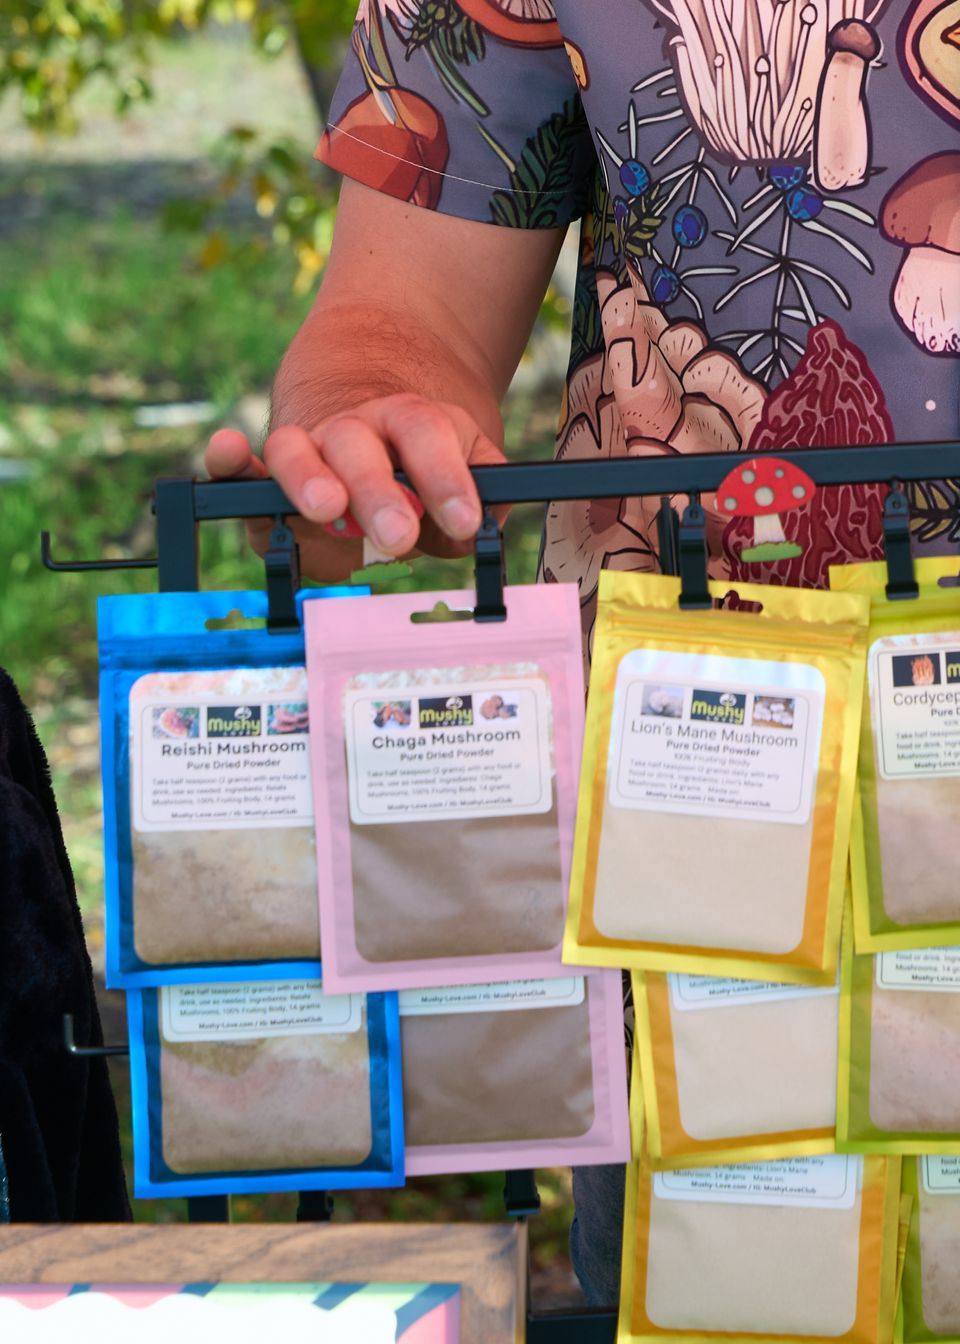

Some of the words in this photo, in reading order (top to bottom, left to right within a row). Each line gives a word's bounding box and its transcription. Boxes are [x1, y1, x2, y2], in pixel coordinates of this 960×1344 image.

[420, 705, 473, 726] Mushy
[691, 700, 744, 725] Mushy
[931, 708, 953, 717] Pure
[208, 716, 260, 735] Mushy
[632, 720, 672, 736] Lion's
[677, 725, 717, 740] Mane
[722, 730, 798, 748] Mushroom
[162, 742, 212, 756] Reishi
[217, 741, 306, 755] Mushroom
[372, 735, 426, 750] Chaga
[432, 729, 520, 745] Mushroom
[666, 739, 689, 750] Pure
[692, 742, 720, 753] Dried
[723, 746, 760, 757] Powder
[401, 752, 423, 761] Pure
[427, 750, 454, 759] Dried
[457, 748, 495, 758] Powder
[187, 761, 210, 770] Pure
[213, 761, 241, 769] Dried
[244, 759, 281, 768] Powder
